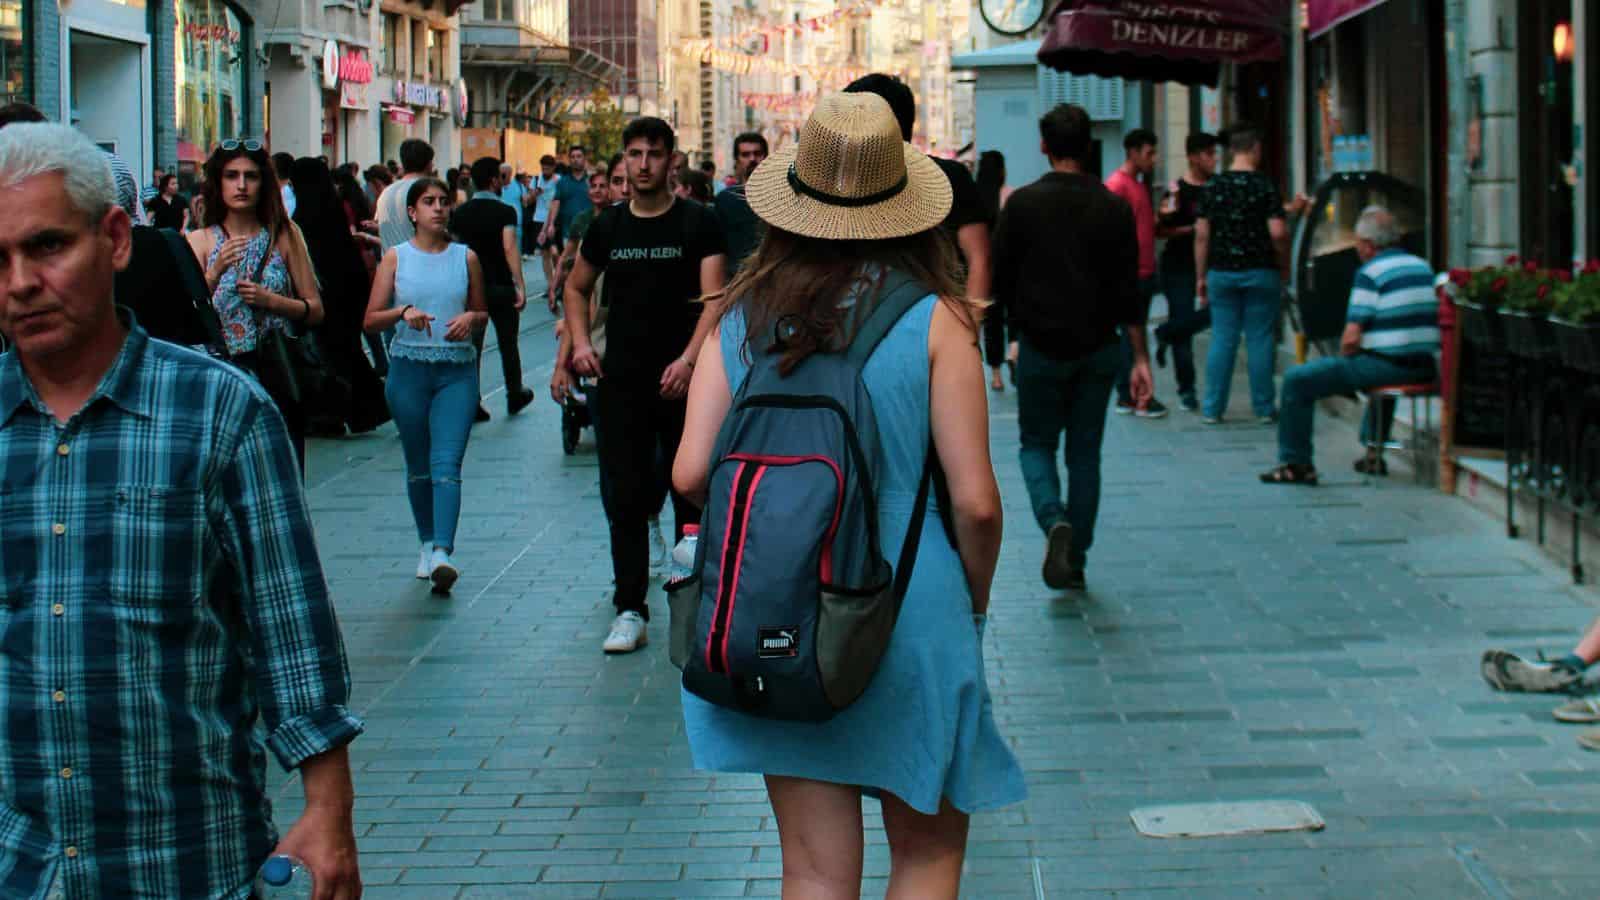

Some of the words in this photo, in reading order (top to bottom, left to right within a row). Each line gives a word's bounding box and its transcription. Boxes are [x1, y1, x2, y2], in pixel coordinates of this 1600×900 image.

[1111, 18, 1249, 51] DENIZLER
[609, 247, 648, 260] CALVIN
[650, 246, 682, 259] KLEIN
[763, 637, 789, 649] PUMA
